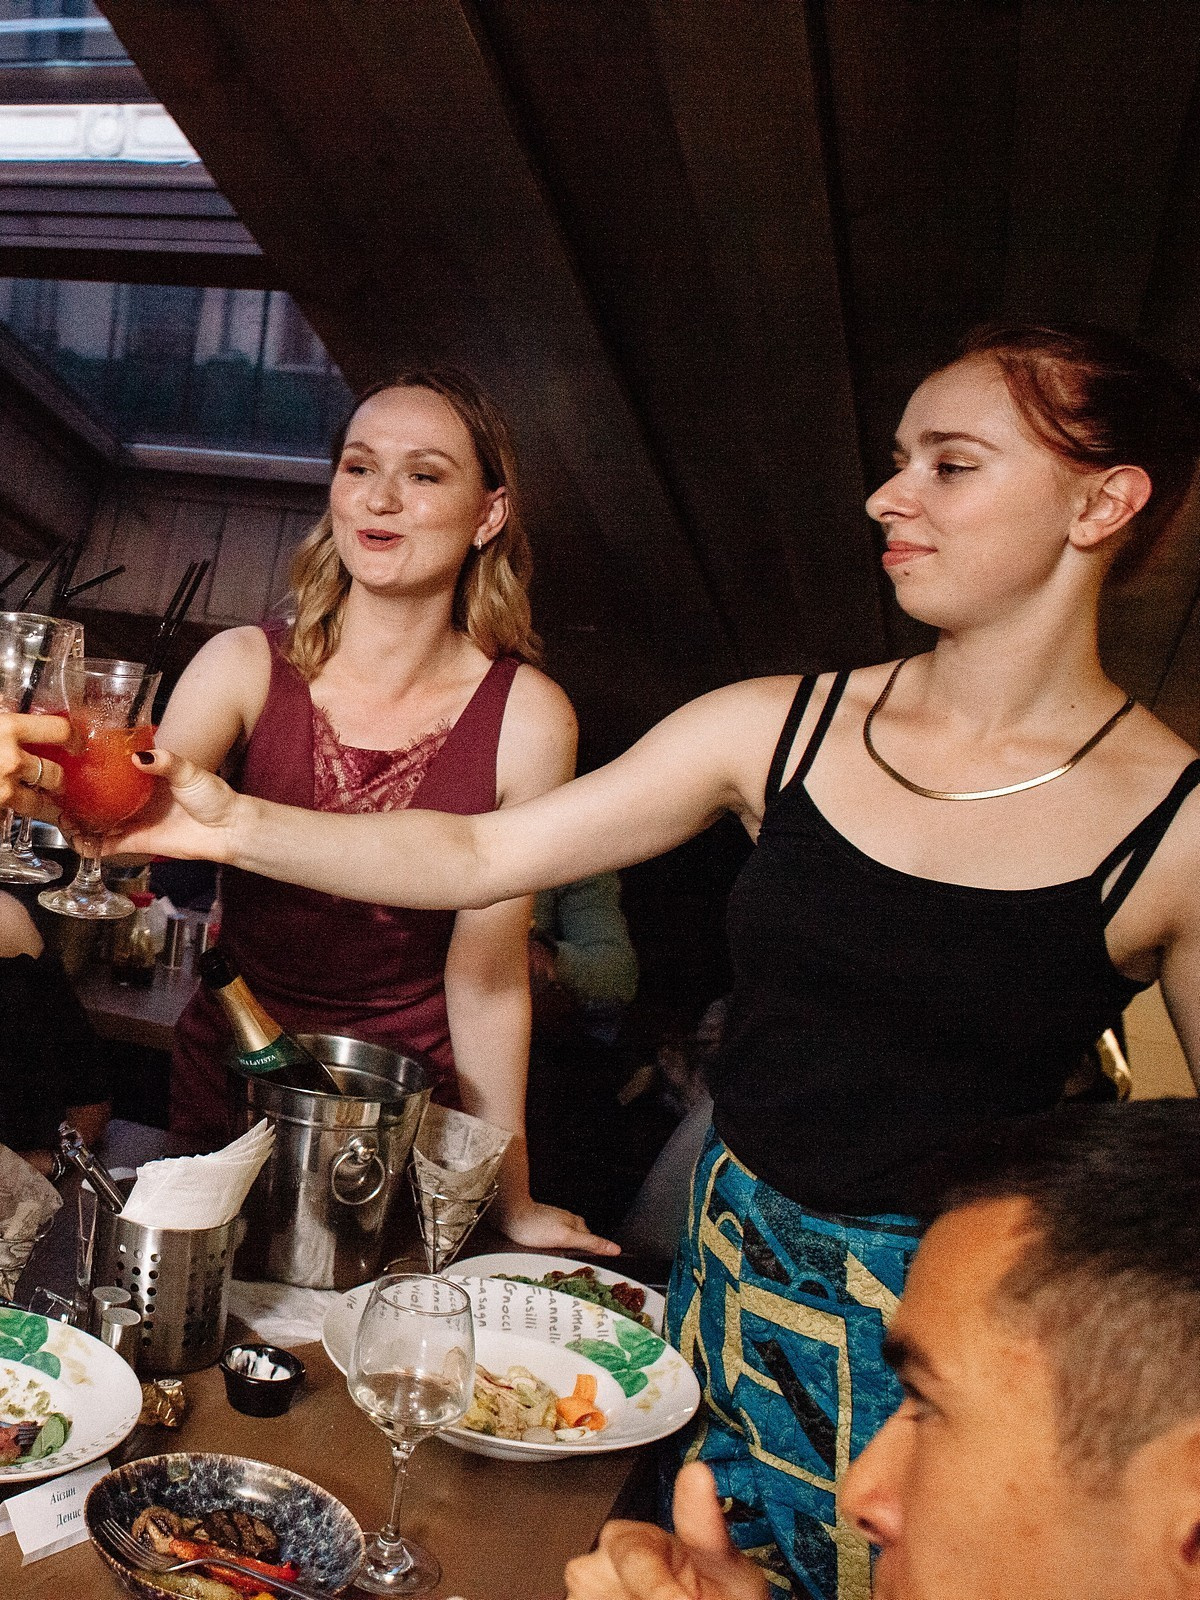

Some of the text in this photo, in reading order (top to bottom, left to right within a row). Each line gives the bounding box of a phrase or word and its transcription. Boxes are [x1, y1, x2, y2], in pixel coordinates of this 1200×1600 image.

[500, 1281, 518, 1332] Gnocci
[525, 1284, 542, 1330] Fusilli
[56, 1508, 82, 1528] Денис
